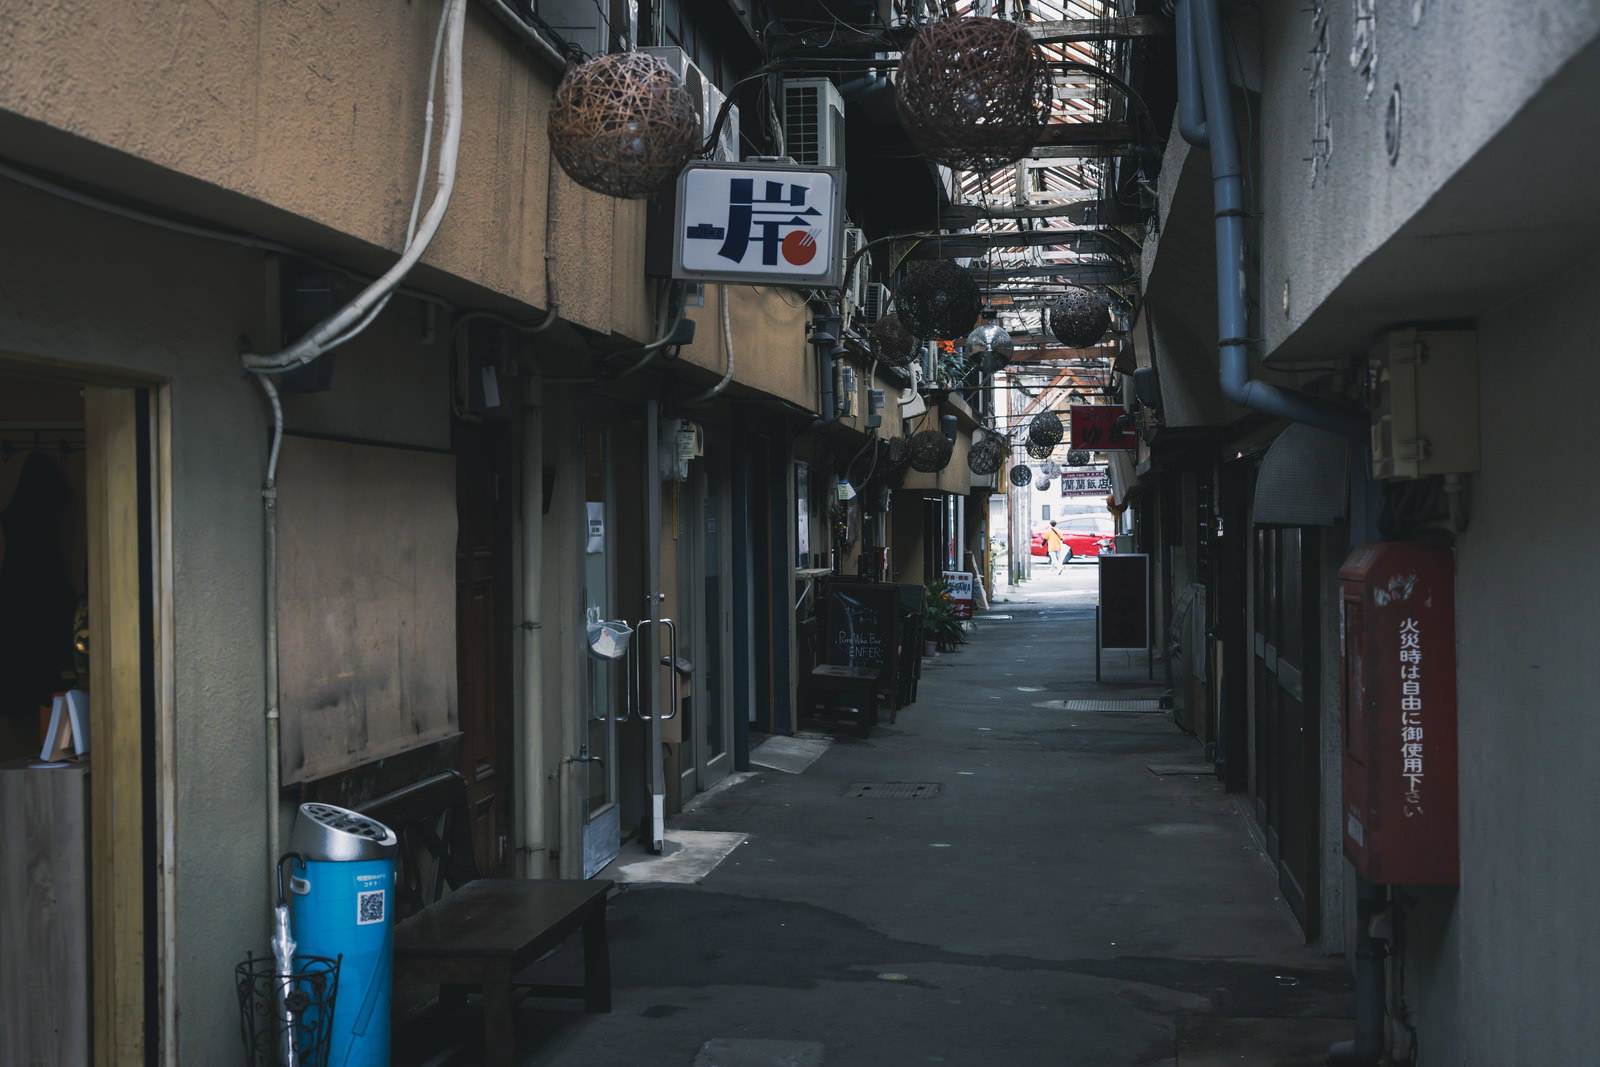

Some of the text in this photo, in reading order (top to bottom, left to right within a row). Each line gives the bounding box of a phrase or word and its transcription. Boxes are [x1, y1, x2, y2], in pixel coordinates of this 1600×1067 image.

[1399, 617, 1424, 818] 火災時は自由に御使用下さい
